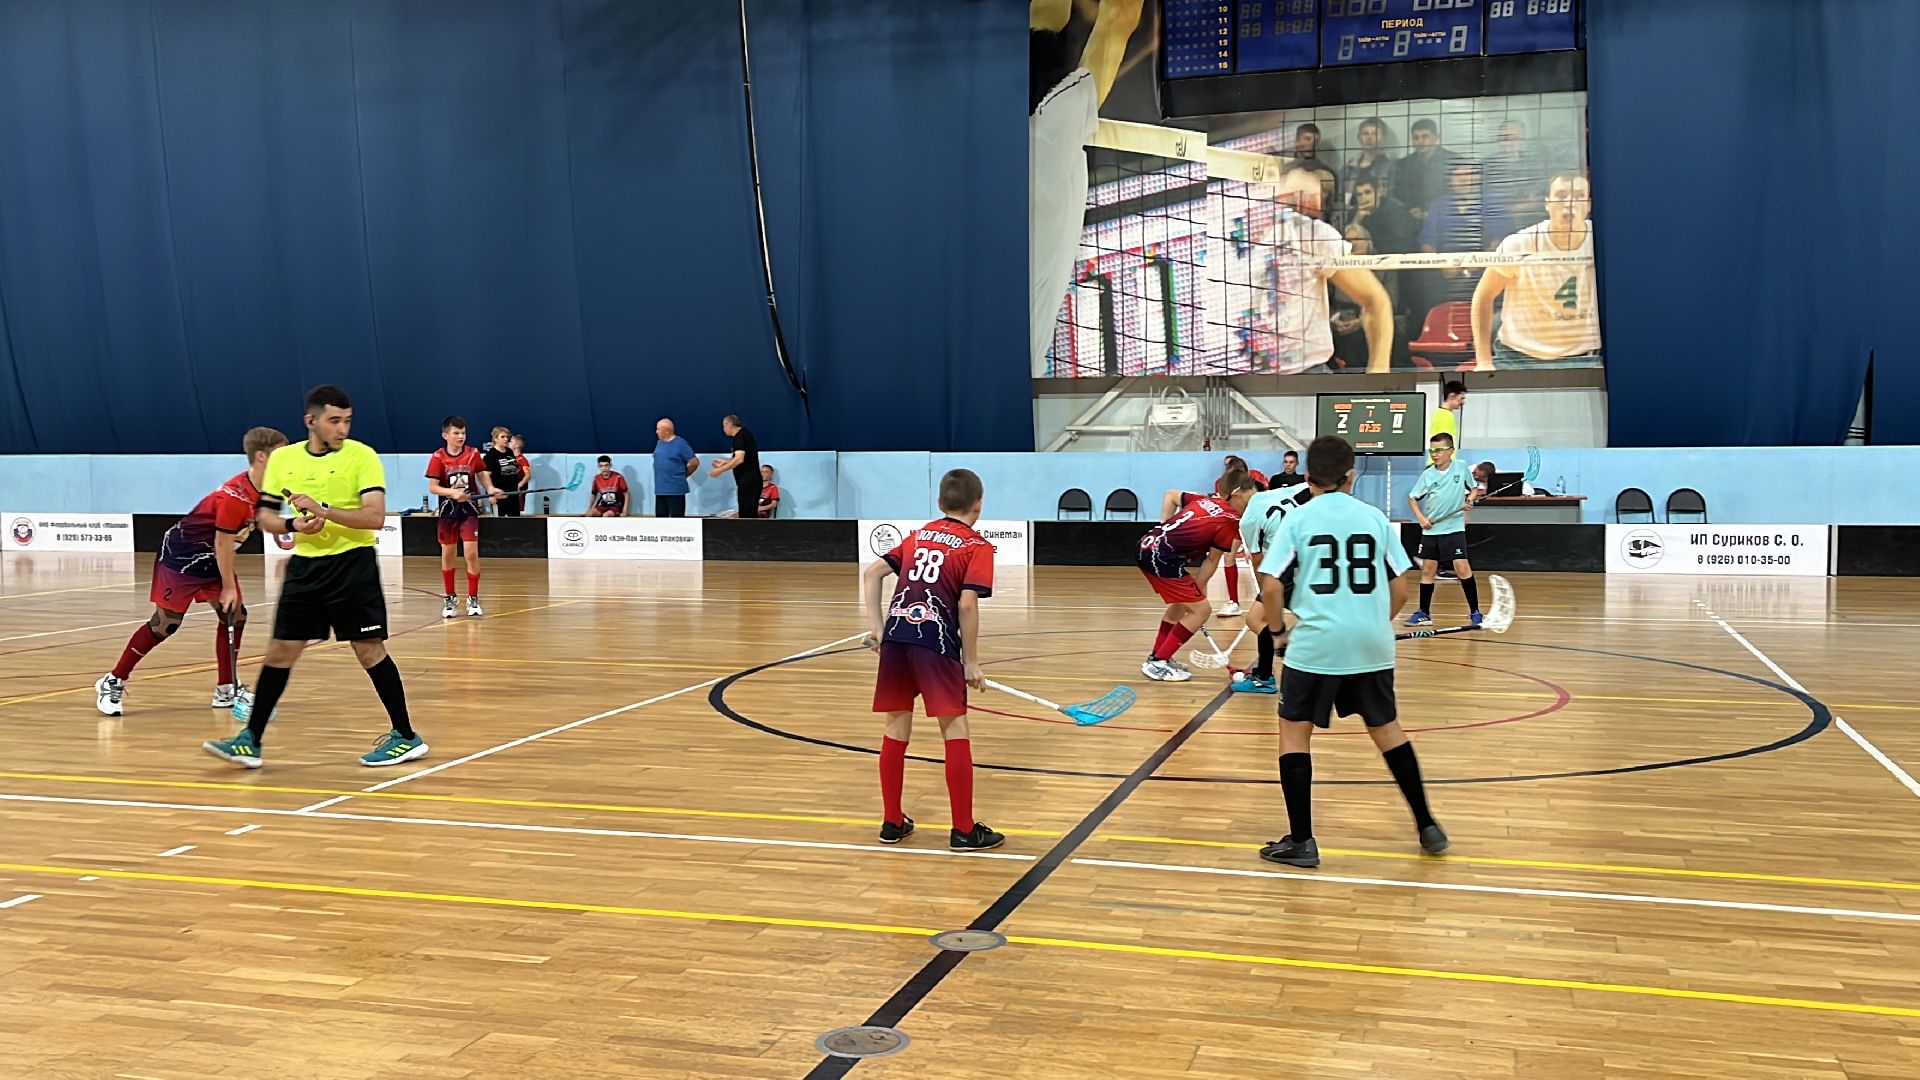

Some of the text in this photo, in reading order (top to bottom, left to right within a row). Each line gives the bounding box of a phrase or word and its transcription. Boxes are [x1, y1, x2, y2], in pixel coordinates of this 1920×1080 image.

[1381, 18, 1424, 29] ПЕРИОД
[1218, 50, 1228, 58] 14
[1468, 254, 1514, 264] Austrian
[1554, 275, 1578, 310] 4
[1337, 413, 1349, 429] 2
[594, 534, 608, 542] ООО
[639, 534, 659, 543] Завод
[983, 530, 1023, 539] Синема»
[1690, 533, 1804, 547] ИП Суриков С. О.
[1308, 533, 1377, 595] 38
[1697, 554, 1791, 565] 8 (926) 010-35-00
[908, 547, 945, 584] 38
